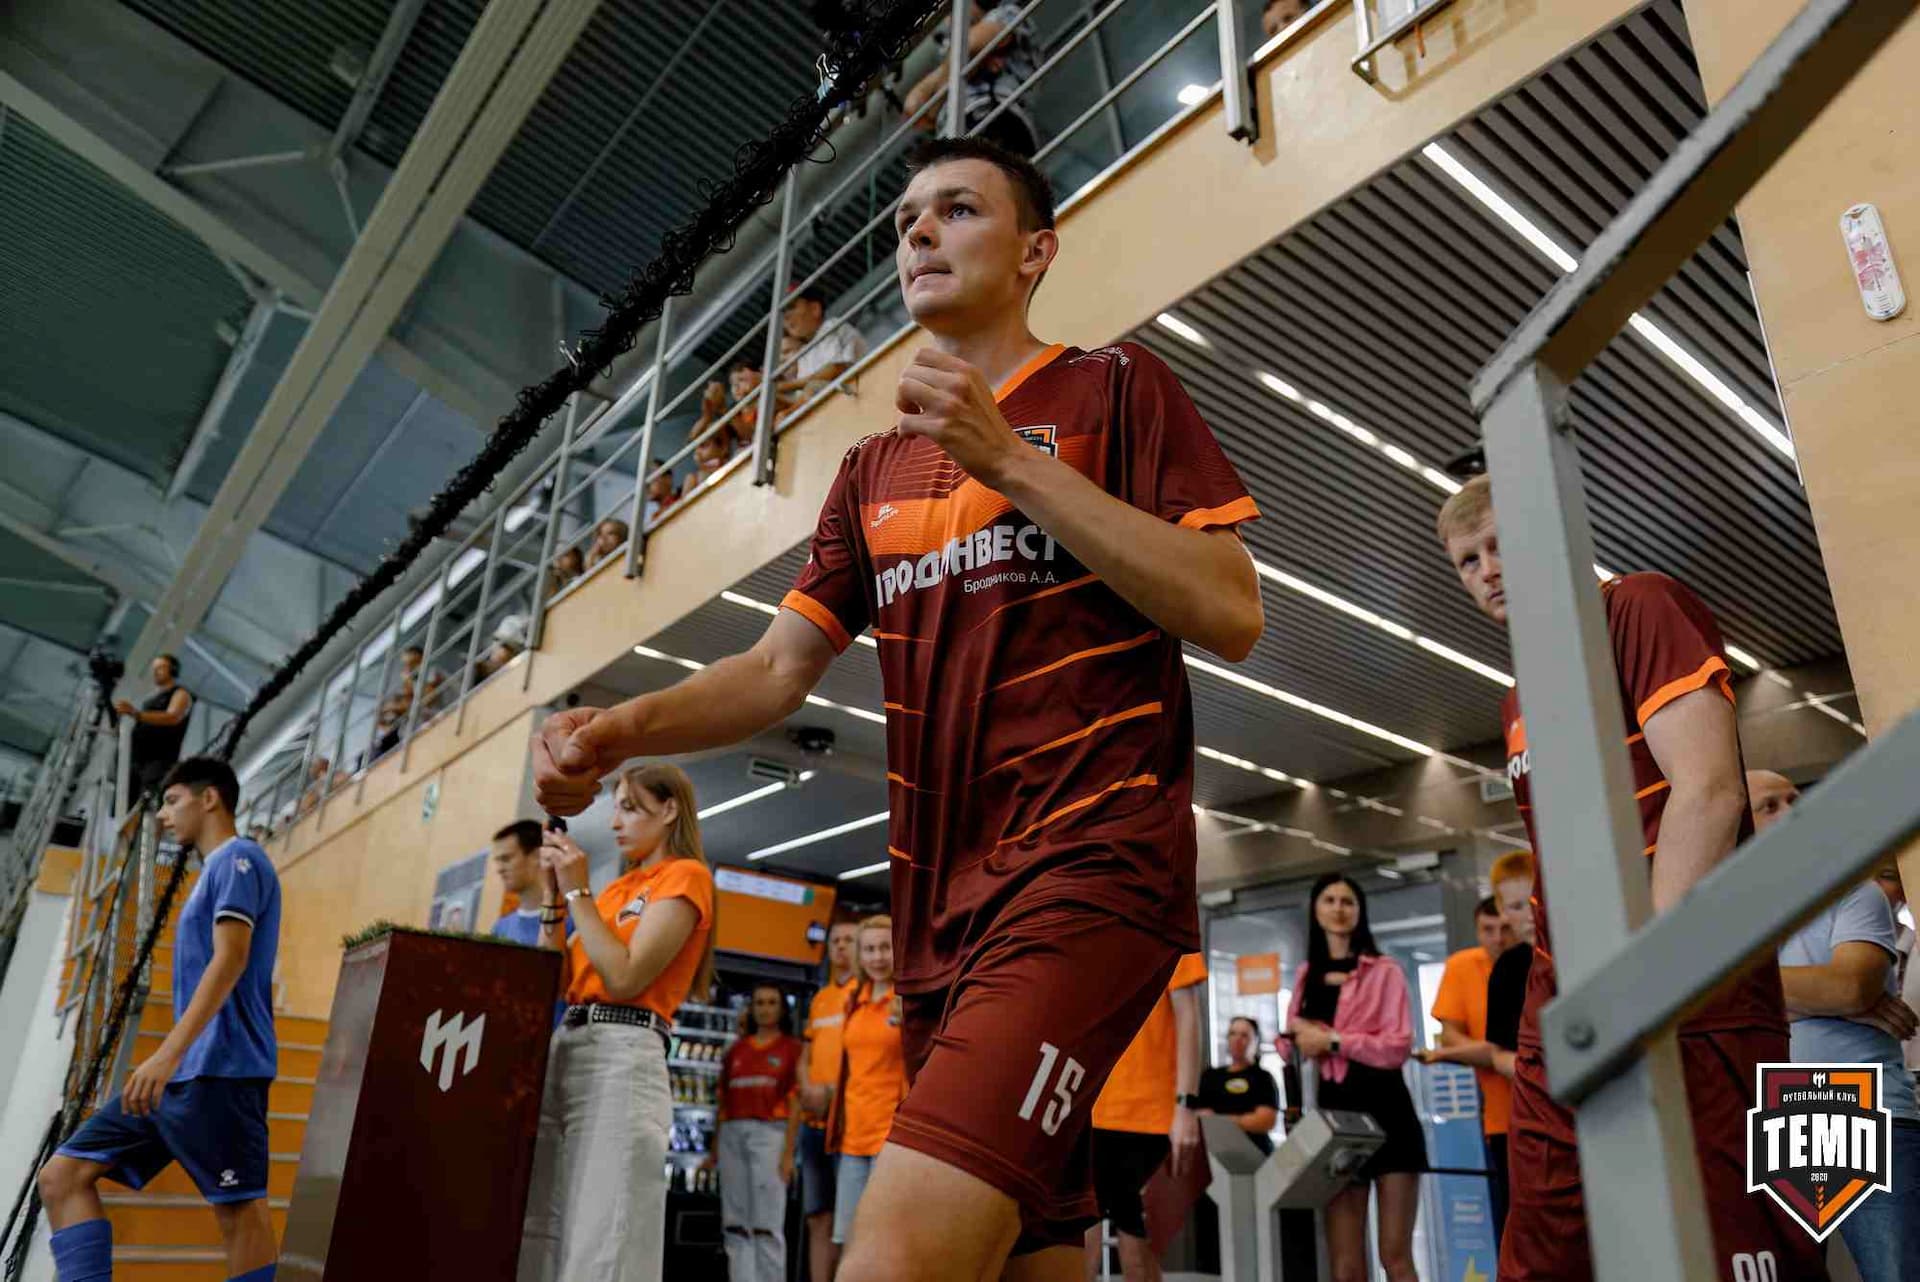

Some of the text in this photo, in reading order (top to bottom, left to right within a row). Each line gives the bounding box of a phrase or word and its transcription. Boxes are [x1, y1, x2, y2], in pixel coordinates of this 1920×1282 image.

[963, 570, 1060, 594] Бродников А.А.
[1017, 1041, 1086, 1137] 15
